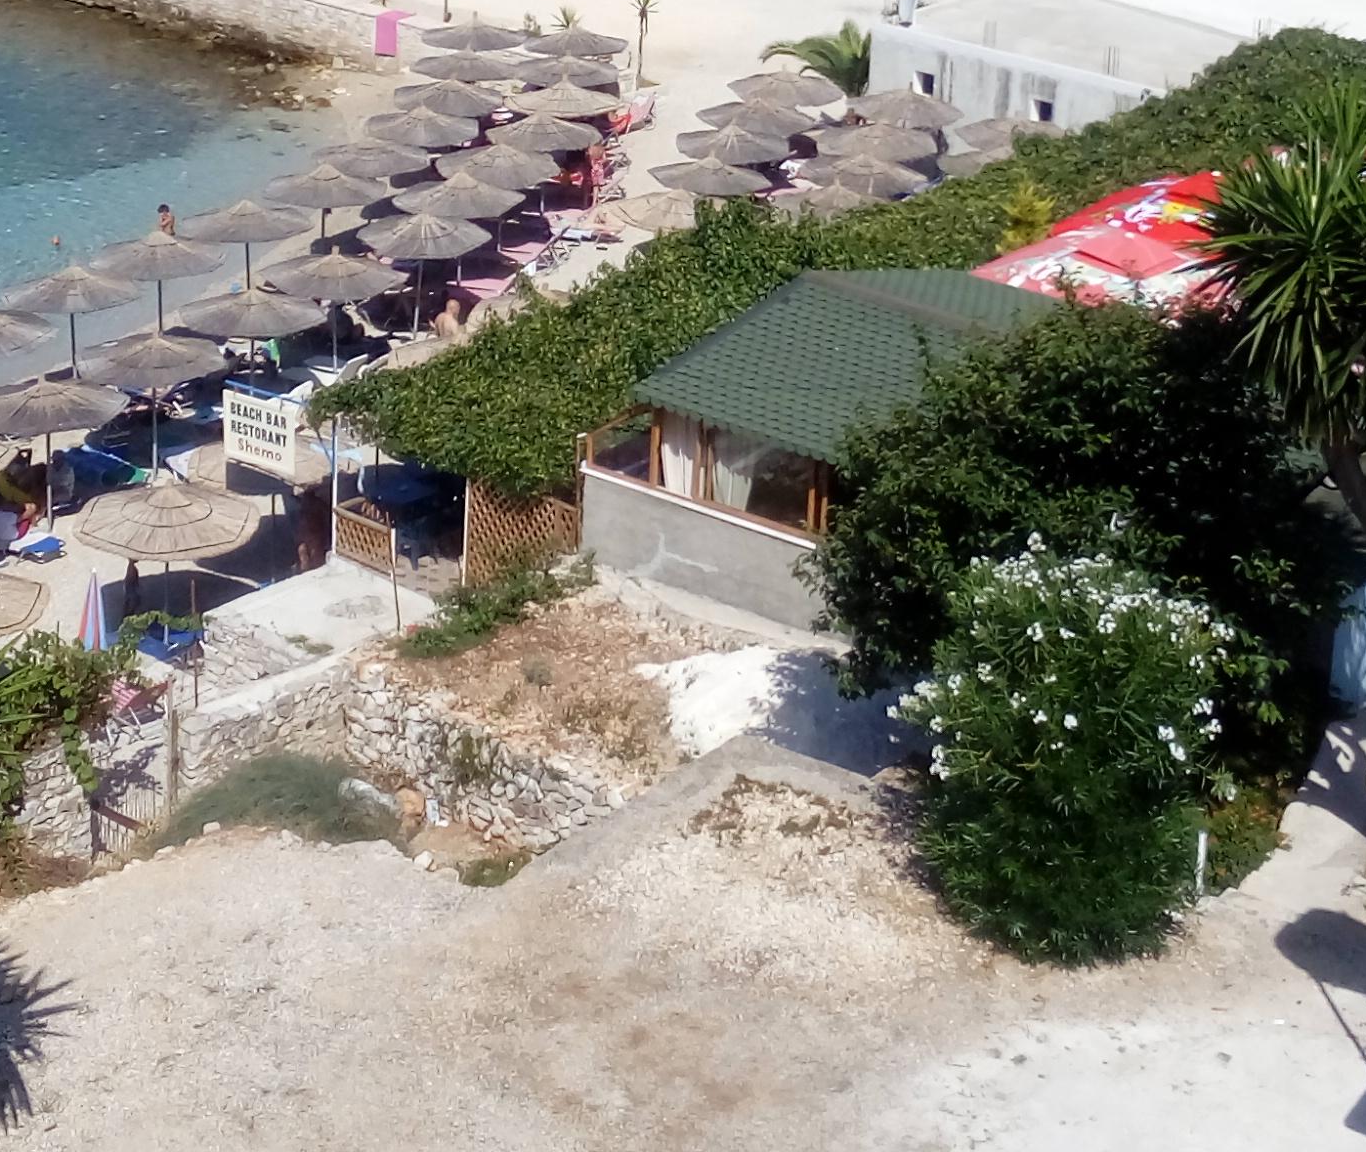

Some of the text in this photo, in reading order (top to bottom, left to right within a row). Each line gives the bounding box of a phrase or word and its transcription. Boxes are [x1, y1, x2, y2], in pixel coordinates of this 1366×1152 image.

[231, 402, 287, 429] BEACH BAR
[231, 420, 287, 447] RESTORANT
[238, 438, 282, 461] Shemo
